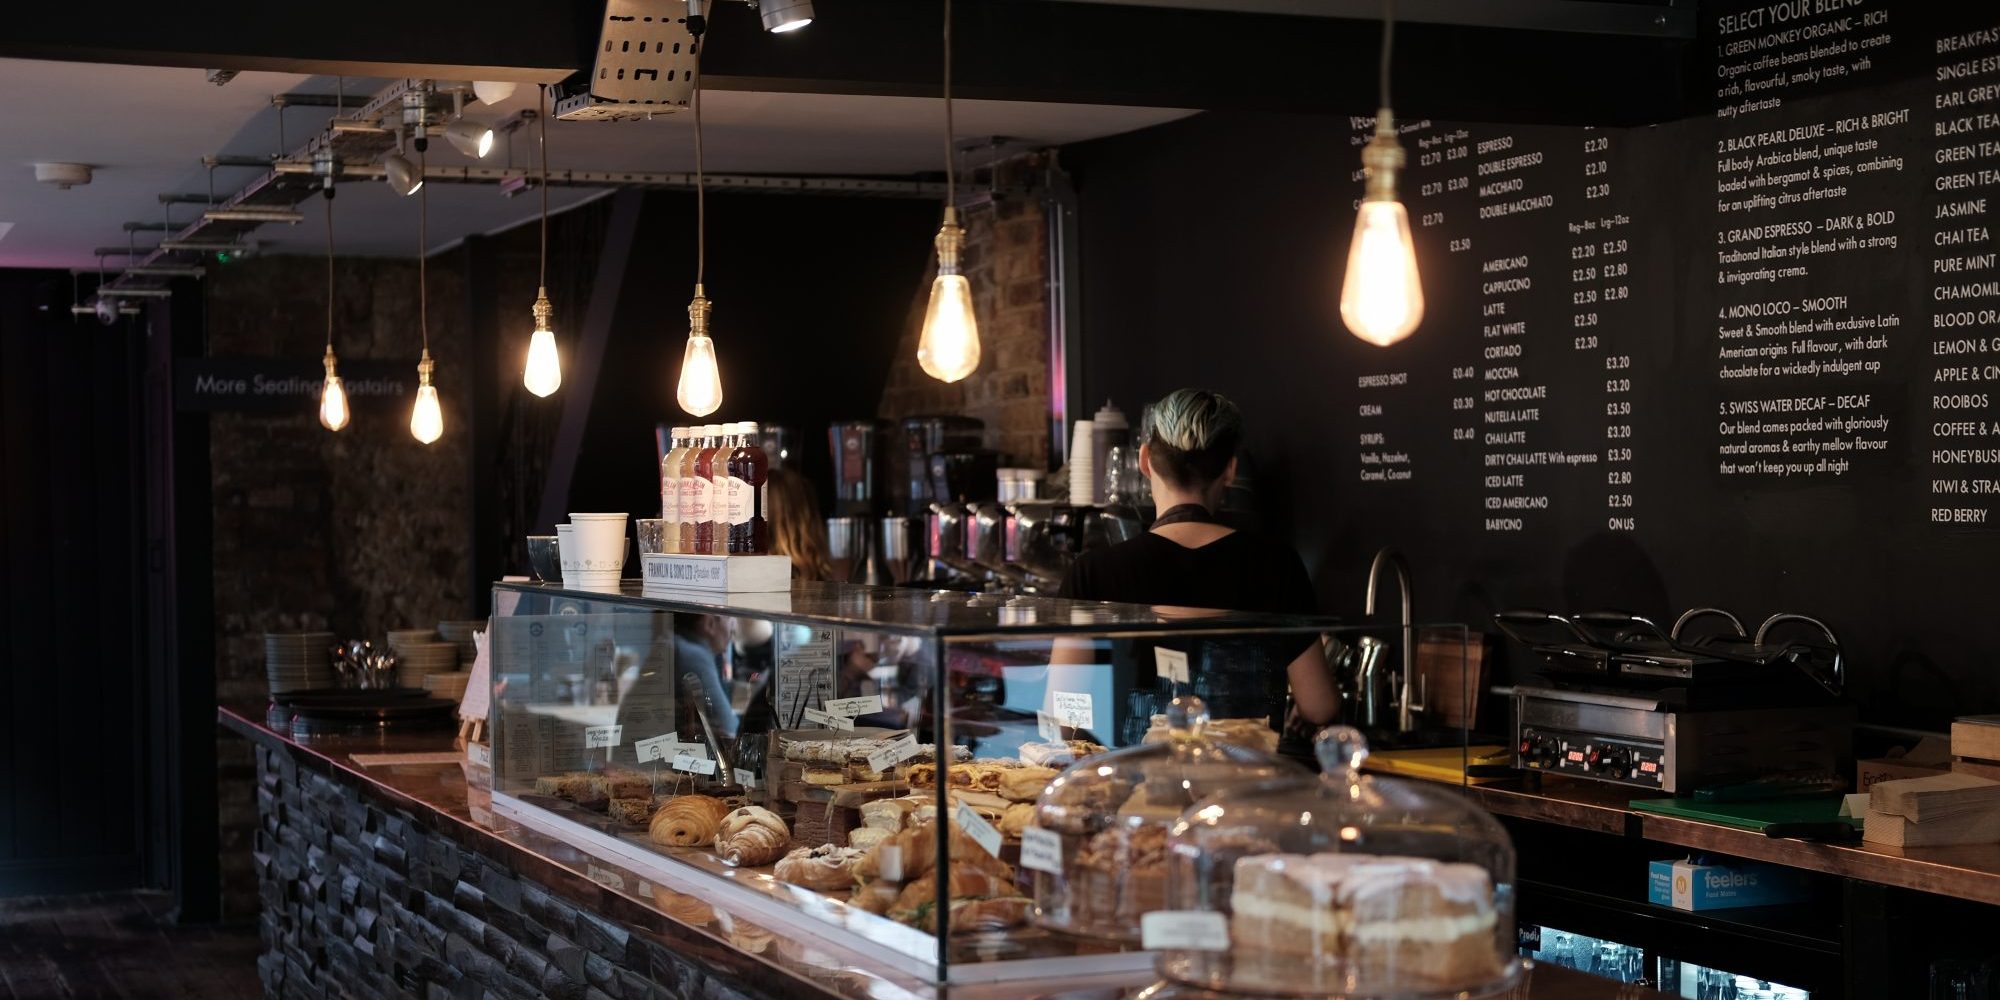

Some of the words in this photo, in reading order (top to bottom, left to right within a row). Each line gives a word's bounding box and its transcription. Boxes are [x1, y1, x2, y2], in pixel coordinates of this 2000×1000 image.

[1719, 8, 1764, 34] SELECT
[1758, 28, 1801, 49] MONKEY
[1803, 18, 1852, 39] ORGANIC
[1718, 62, 1751, 79] Organic
[1937, 60, 1978, 81] SINGLE
[1740, 97, 1781, 114] aftertaste
[1936, 91, 1965, 109] EARL
[1968, 84, 2000, 103] GREY
[1728, 135, 1756, 152] BLACK
[1758, 131, 1787, 146] PEARL
[1789, 124, 1824, 141] DELUXE
[1836, 118, 1859, 134] RICH
[1872, 109, 1909, 128] BRIGHT
[1935, 117, 1973, 136] BLACK
[1977, 113, 2000, 129] TEA
[1478, 136, 1513, 154] ESPRESSO
[1756, 151, 1792, 167] Arabica
[1824, 143, 1853, 158] unique
[1856, 139, 1877, 152] taste
[1935, 145, 1975, 163] GREEN
[1979, 141, 2000, 157] TEA
[1421, 152, 1441, 166] £2.70
[1447, 146, 1468, 160] £3.00
[1478, 160, 1506, 176] DOUBLE
[1507, 152, 1542, 169] ESPRESSO
[1585, 138, 1608, 152] £2.20
[1480, 178, 1523, 197] MACCHIATO
[1586, 161, 1607, 175] £2.10
[1718, 176, 1746, 192] loaded
[1768, 170, 1810, 187] bergamot
[1857, 156, 1903, 173] combining
[1936, 173, 1975, 190] GREEN
[1979, 169, 2000, 185] TEA
[1422, 182, 1442, 196] £2.70
[1448, 177, 1468, 191] £3.00
[1480, 203, 1507, 219] DOUBLE
[1509, 195, 1553, 213] MACCHIATO
[1587, 184, 1609, 198] £2.30
[1743, 194, 1776, 212] uplifting
[1778, 189, 1800, 205] citrus
[1803, 186, 1847, 202] aftertaste
[1935, 199, 1986, 218] JASMINE
[1422, 212, 1443, 227] £2.70
[1728, 227, 1762, 243] GRAND
[1765, 221, 1812, 239] ESPRESSO
[1826, 216, 1853, 231] DARK
[1867, 210, 1895, 226] BOLD
[1935, 230, 1963, 245] CHAI
[1967, 227, 1989, 241] TEA
[1483, 256, 1528, 273] AMERICANO
[1572, 245, 1595, 259] £2.20
[1603, 240, 1627, 254] £2.50
[1719, 247, 1760, 264] Traditional
[1762, 245, 1787, 259] Italian
[1811, 239, 1835, 253] blend
[1838, 236, 1857, 250] with
[1868, 235, 1897, 250] strong
[1934, 258, 1962, 273] PURE
[1966, 254, 1996, 270] MINT
[1483, 277, 1530, 294] CAPPUCCINO
[1573, 268, 1596, 281] £2.50
[1604, 263, 1628, 277] £2.80
[1727, 266, 1775, 285] invigorating
[1484, 303, 1505, 316] LATTE
[1574, 291, 1596, 304] £2.50
[1605, 286, 1628, 300] £2.80
[1729, 304, 1761, 318] MONO
[1763, 301, 1790, 315] LOCO
[1802, 296, 1848, 312] SMOOTH
[1484, 325, 1500, 338] FLAT
[1503, 322, 1525, 335] WHITE
[1575, 313, 1597, 326] £2.50
[1719, 326, 1744, 339] Sweet
[1756, 321, 1787, 337] Smooth
[1789, 319, 1813, 334] blend
[1815, 317, 1833, 331] with
[1836, 316, 1875, 330] exclusive
[1878, 313, 1899, 328] Latin
[1934, 312, 1974, 328] BLOOD
[1485, 345, 1521, 359] CORTADO
[1575, 336, 1597, 349] £2.30
[1719, 346, 1758, 359] American
[1760, 343, 1787, 359] origins
[1845, 335, 1863, 350] with
[1866, 335, 1888, 349] dark
[1934, 339, 1975, 355] LEMON
[1359, 375, 1389, 387] ESPRESSO
[1453, 367, 1474, 379] £0.40
[1485, 367, 1518, 380] MOCCHA
[1607, 356, 1629, 369] £3.20
[1720, 365, 1758, 379] chocolate
[1782, 360, 1821, 377] wickedly
[1823, 360, 1862, 375] indulgent
[1934, 368, 1968, 382] APPLE
[196, 375, 245, 395] More
[253, 374, 321, 397] Seating
[1485, 390, 1500, 402] HOT
[1501, 386, 1546, 400] CHOCOLATE
[1607, 379, 1629, 392] £3.20
[1360, 405, 1381, 416] CREAM
[1453, 397, 1474, 409] £0.30
[1730, 401, 1758, 414] SWISS
[1760, 399, 1792, 413] WATER
[1795, 397, 1826, 411] DECAF
[1837, 395, 1870, 409] DECAF
[1934, 394, 1988, 409] ROOIBOS
[1518, 409, 1539, 421] LATTE
[1607, 402, 1630, 415] £3.50
[1454, 428, 1474, 440] £0.40
[1505, 432, 1526, 443] LATTE
[1608, 425, 1630, 438] £3.20
[1720, 422, 1735, 435] Our
[1737, 420, 1760, 434] blend
[1762, 423, 1788, 433] comes
[1790, 418, 1822, 435] packed
[1825, 416, 1843, 430] with
[1845, 415, 1888, 433] gloriously
[1934, 422, 1975, 436] COFFEE
[1720, 441, 1747, 454] natural
[1749, 443, 1780, 453] aromas
[1792, 438, 1820, 455] earthy
[1822, 437, 1853, 451] mellow
[1856, 436, 1888, 450] flavour
[1485, 454, 1505, 466] DIRTY
[1525, 452, 1547, 464] LATTE
[1567, 453, 1598, 466] espresso
[1608, 449, 1631, 461] £3.50
[1720, 461, 1735, 474] that
[1763, 460, 1784, 476] keep
[1786, 463, 1801, 476] you
[1828, 458, 1849, 475] night
[1486, 476, 1501, 487] ICED
[1503, 475, 1523, 487] LATTE
[1609, 472, 1631, 484] £2.80
[1933, 480, 1958, 493] KIWI
[1486, 498, 1501, 509] ICED
[1503, 497, 1547, 509] AMERICANO
[1609, 495, 1632, 507] £2.50
[1486, 519, 1522, 530] BABYCINO
[1932, 509, 1951, 522] RED
[1954, 509, 1987, 522] BERRY
[649, 563, 668, 577] FRANKLIN
[674, 564, 684, 579] SONS
[1705, 872, 1758, 888] feelers
